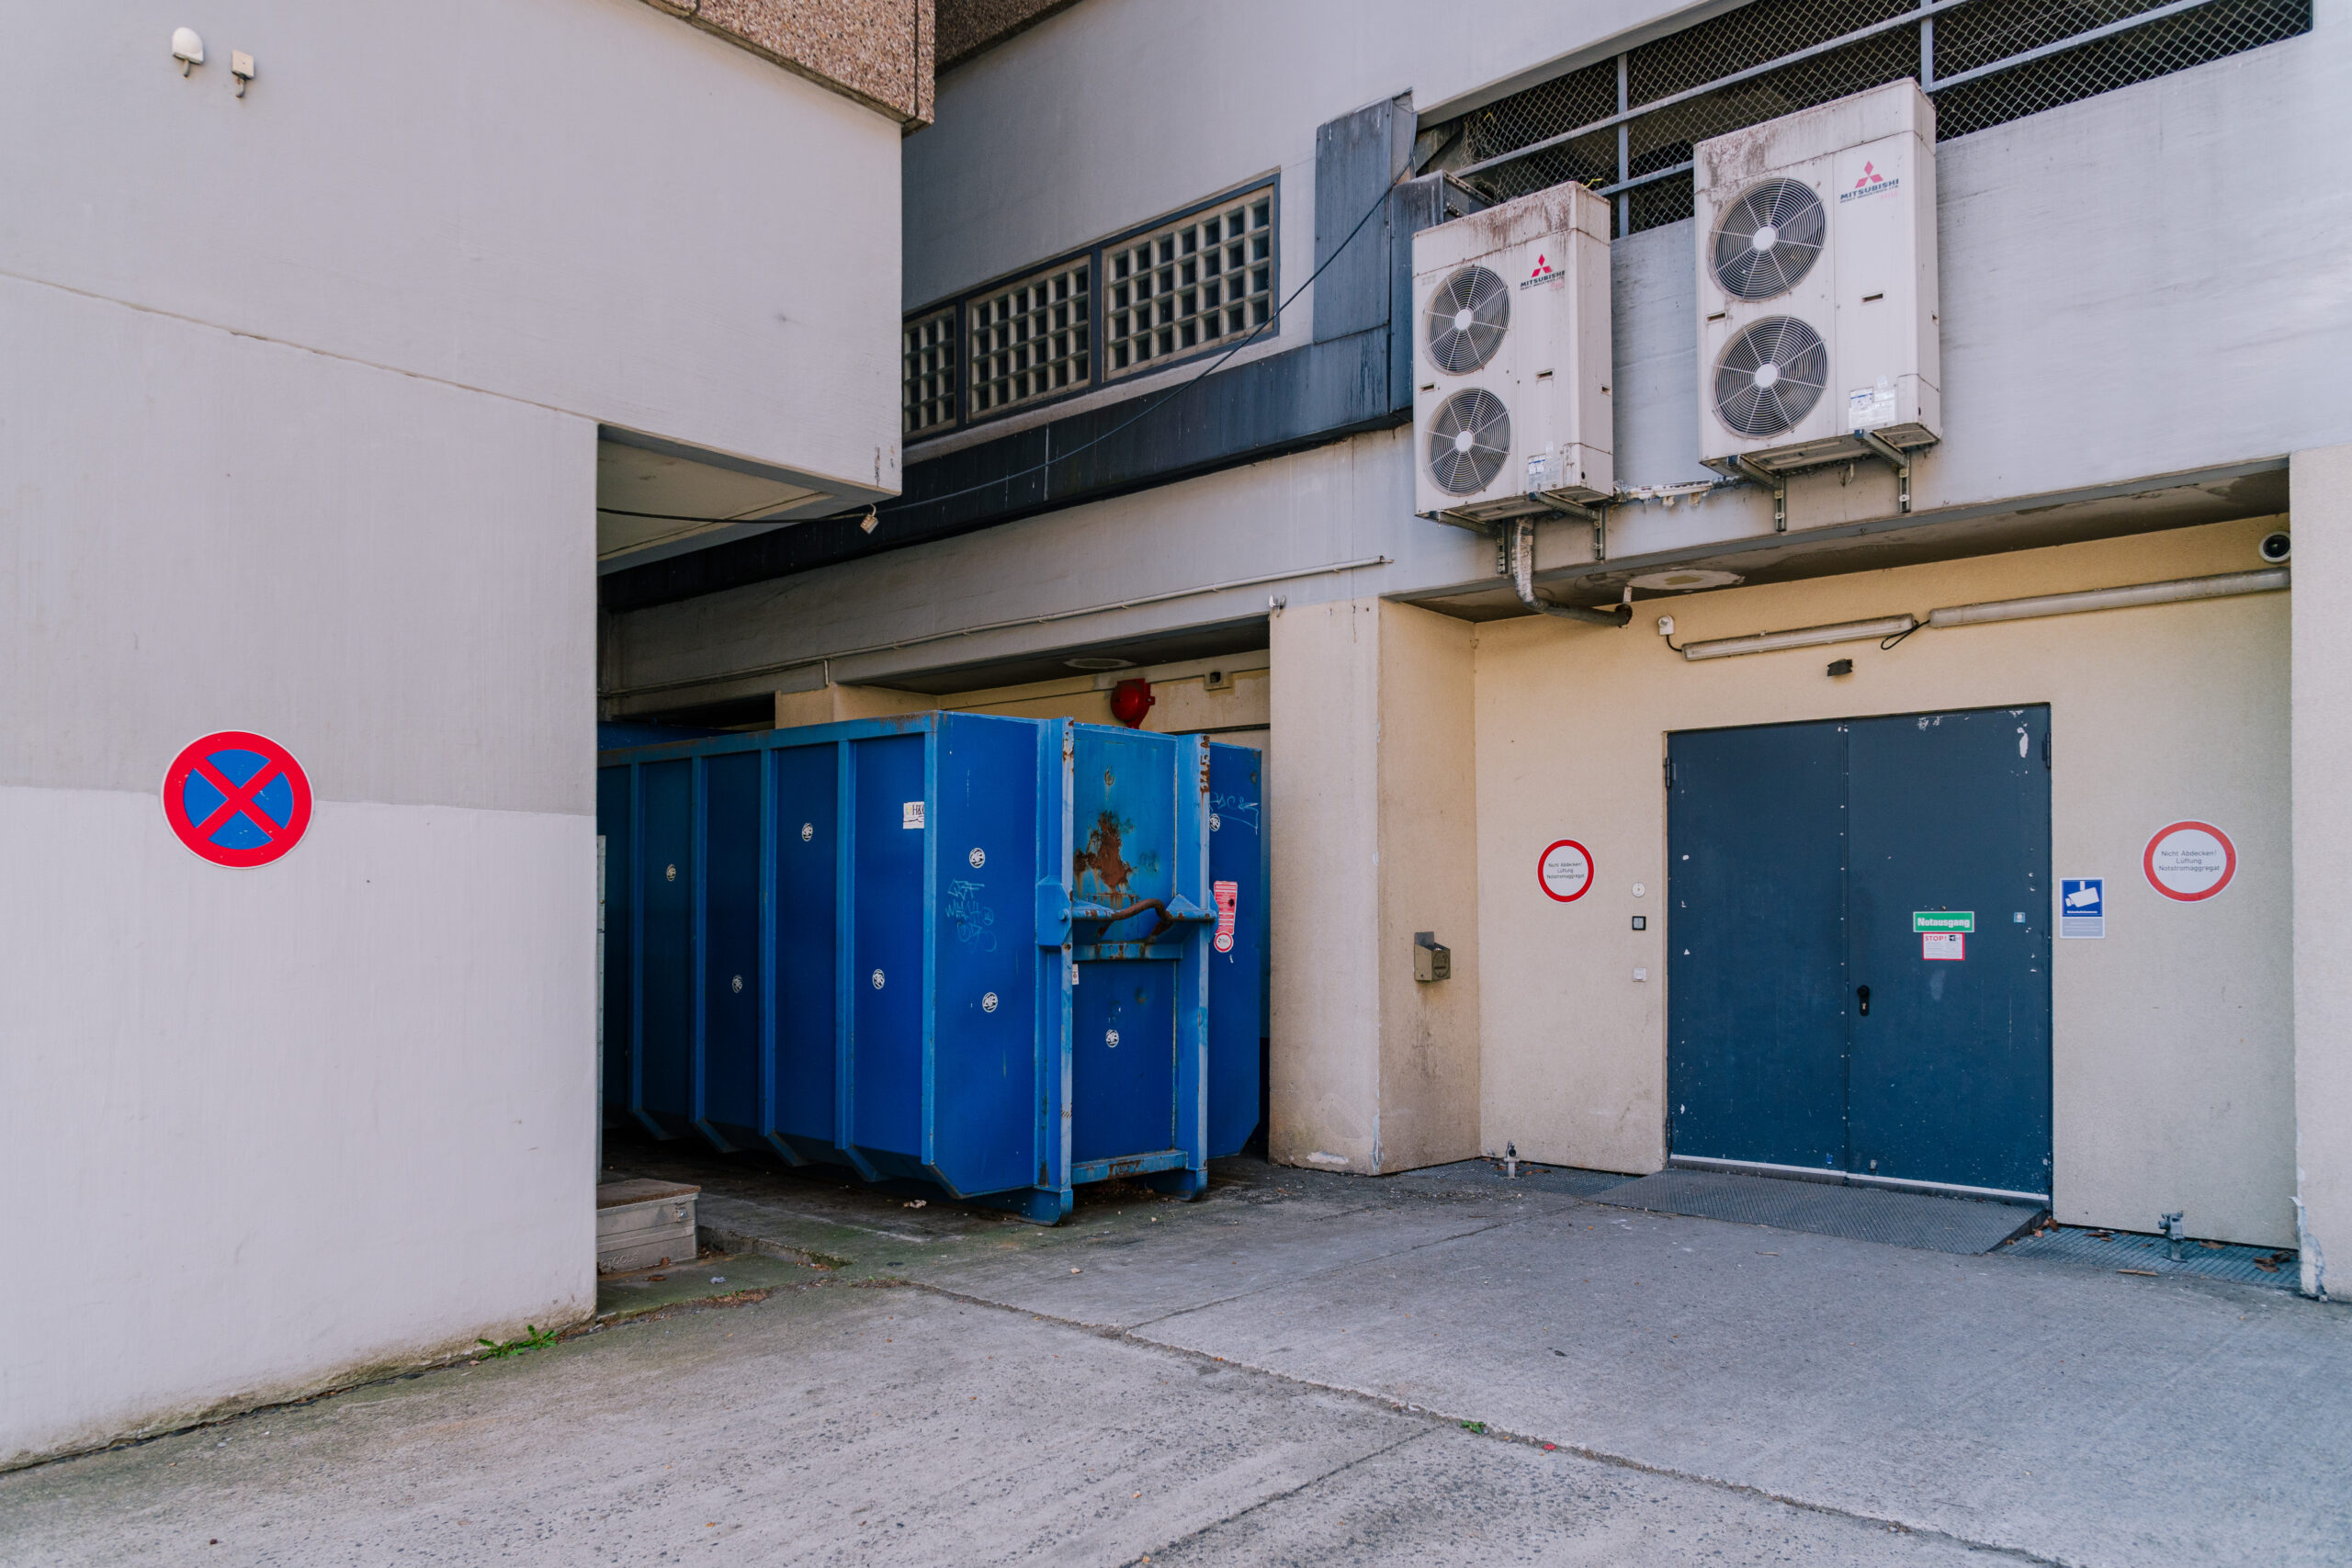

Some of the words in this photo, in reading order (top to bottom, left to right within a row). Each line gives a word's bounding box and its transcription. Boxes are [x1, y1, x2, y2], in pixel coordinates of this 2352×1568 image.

[1840, 178, 1899, 199] MITSUBISHI
[1520, 270, 1565, 288] MITSUBISHI
[1917, 917, 1970, 928] Notausgang
